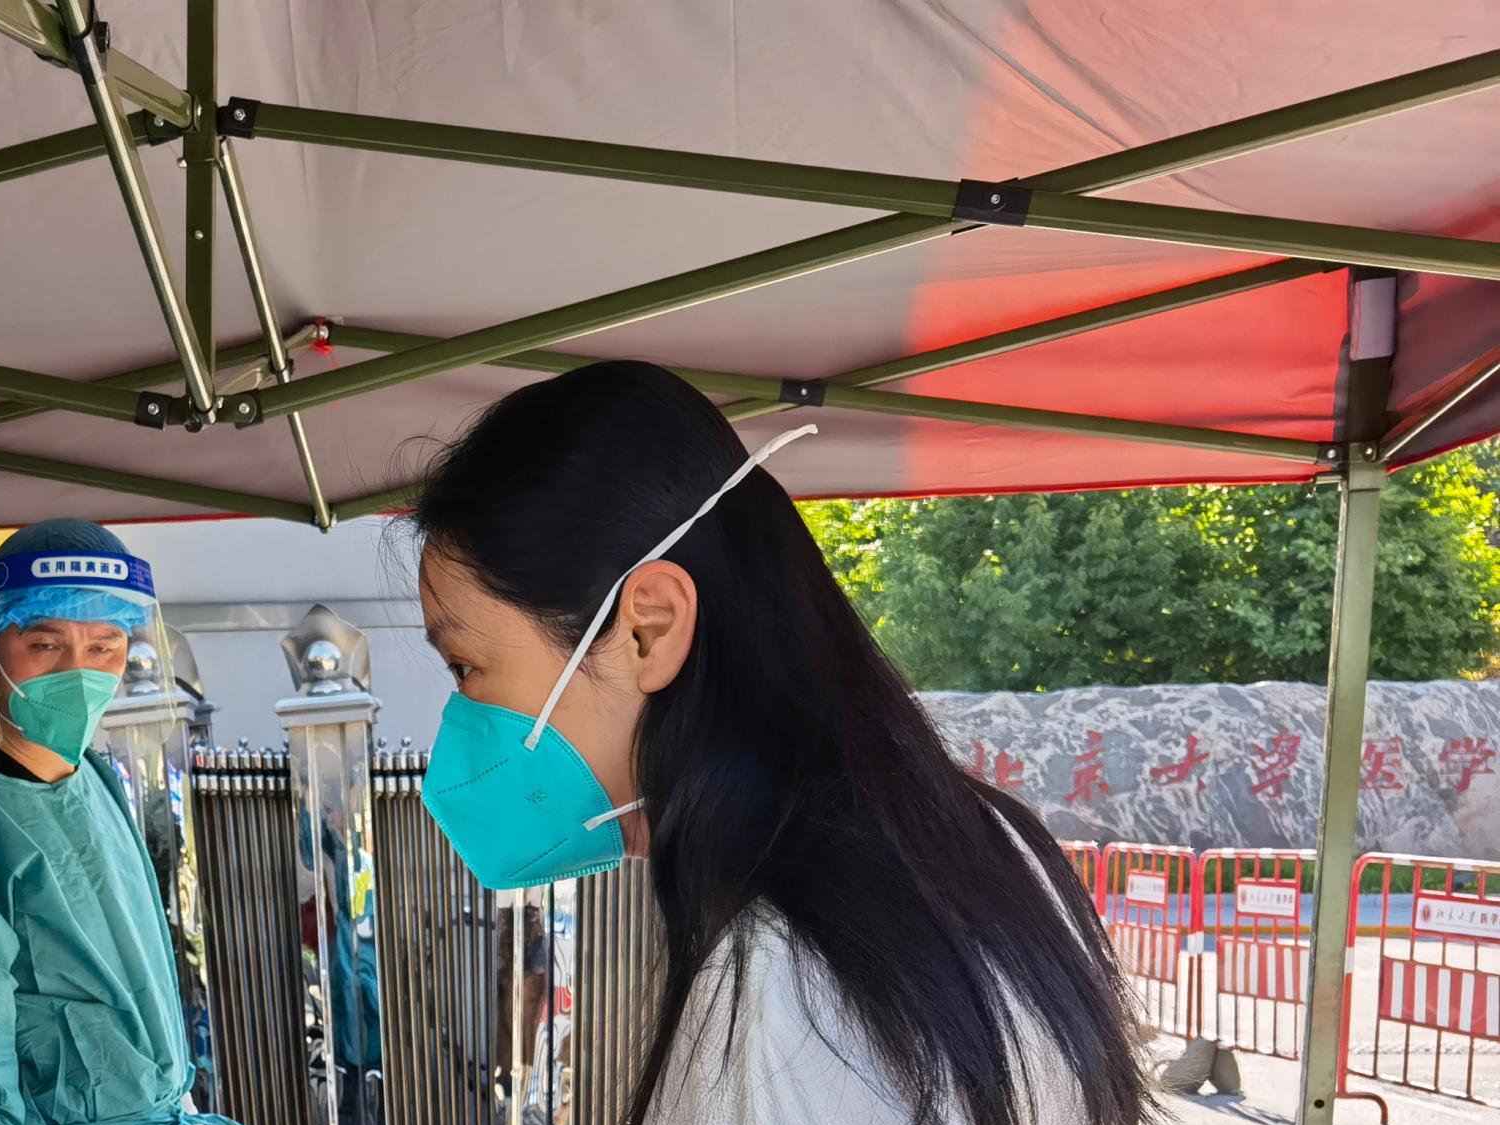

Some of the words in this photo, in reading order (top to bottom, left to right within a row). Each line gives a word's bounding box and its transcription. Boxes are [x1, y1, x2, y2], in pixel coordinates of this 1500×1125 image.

[40, 561, 122, 575] 医用隔离面罩
[524, 788, 548, 804] N95
